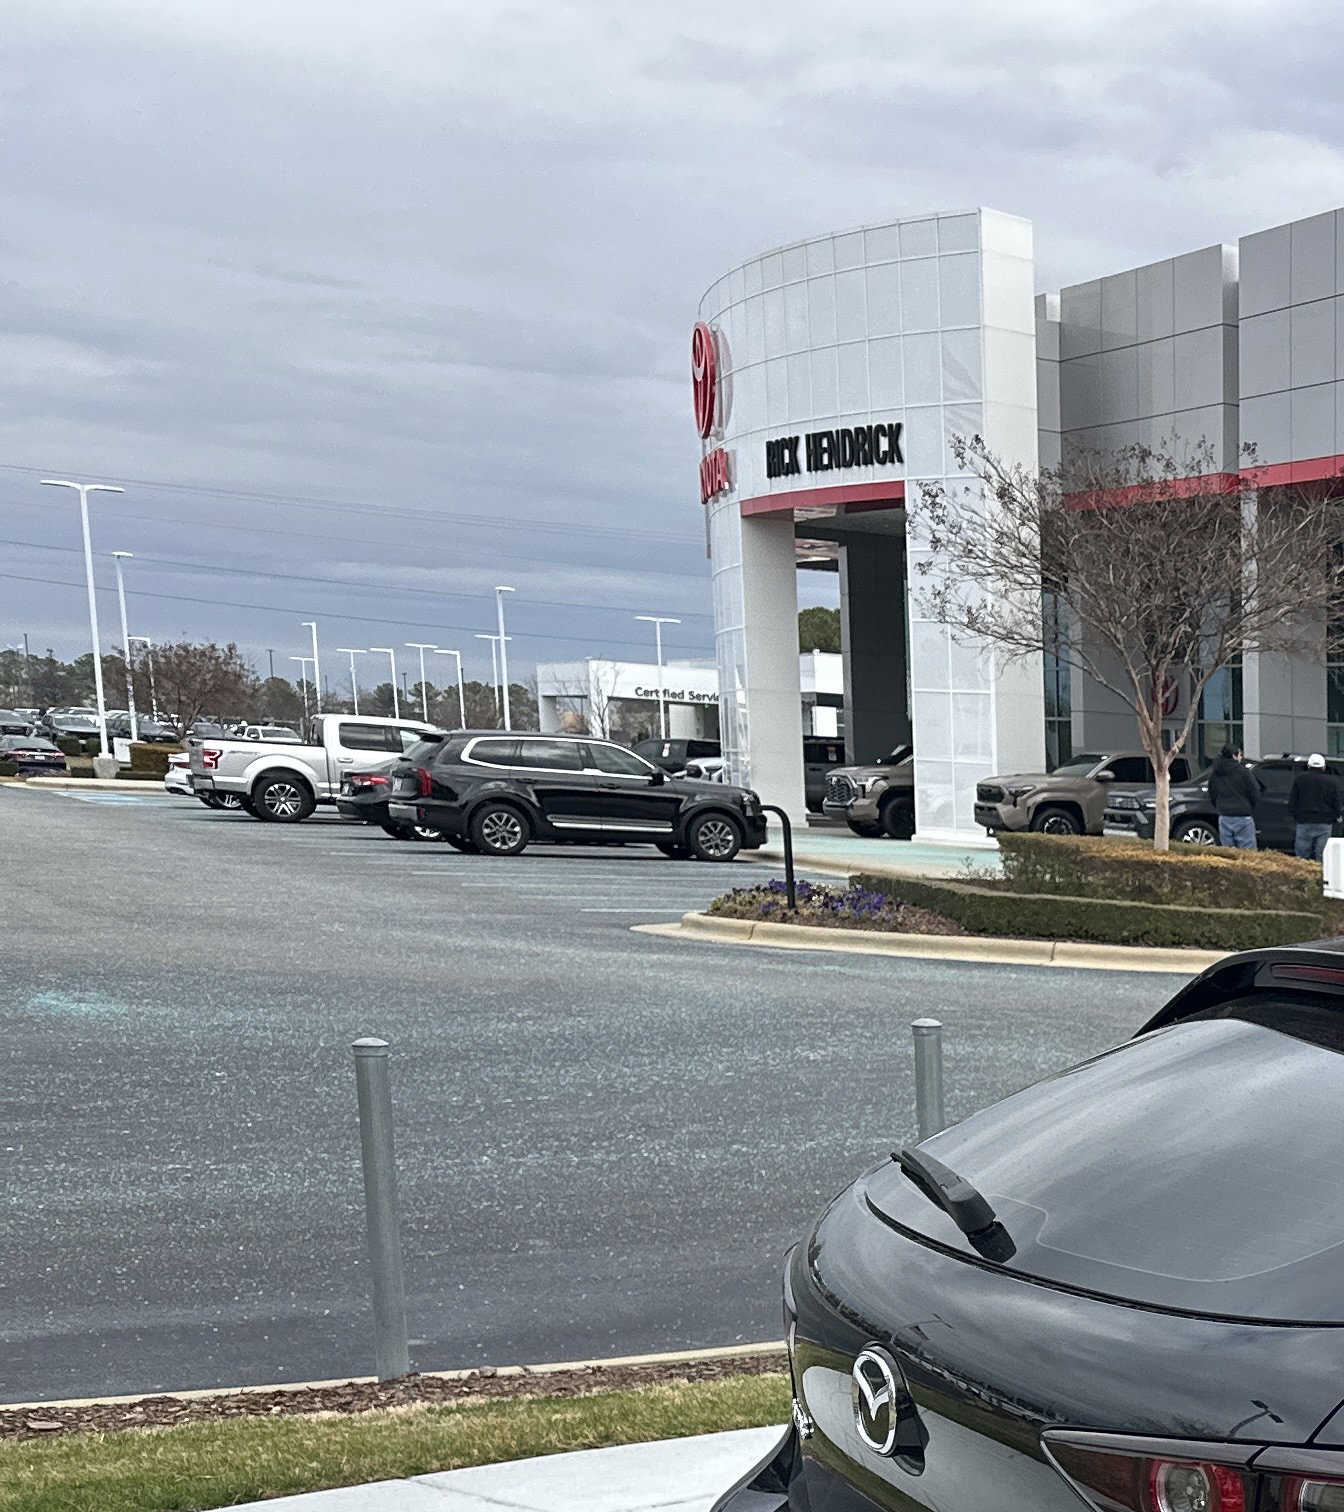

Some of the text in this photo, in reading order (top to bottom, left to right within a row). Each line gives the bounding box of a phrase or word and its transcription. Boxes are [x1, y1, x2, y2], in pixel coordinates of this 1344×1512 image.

[766, 422, 904, 478] RICK HENDRICK
[634, 686, 685, 700] Certfied
